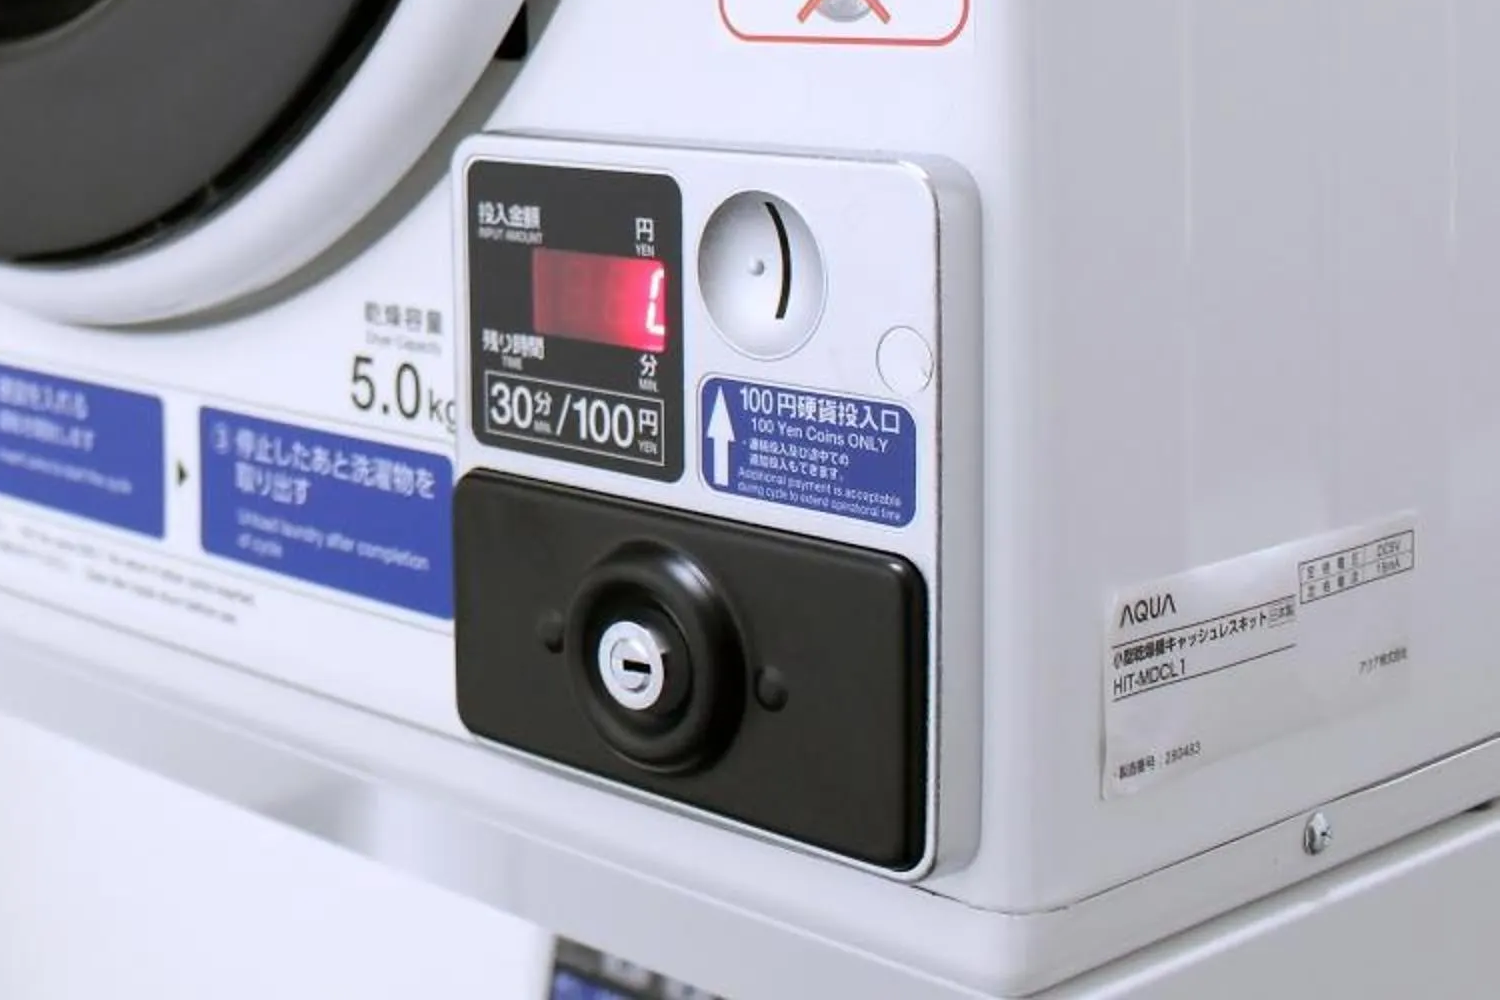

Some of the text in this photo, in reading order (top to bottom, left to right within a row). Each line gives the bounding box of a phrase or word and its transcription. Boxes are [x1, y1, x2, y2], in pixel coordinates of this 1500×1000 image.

[479, 201, 541, 229] 投入金額
[635, 217, 654, 242] 円
[636, 243, 654, 257] YEN
[483, 328, 544, 360] 残り時間
[640, 353, 657, 376] 分
[752, 418, 888, 453] 100 Yen Coins ONLY
[235, 428, 435, 499] 停止したあと洗濯物を
[235, 461, 311, 505] 取り出す
[737, 466, 786, 485] Additional
[788, 476, 831, 495] payment
[834, 486, 843, 496] is
[1119, 593, 1177, 628] AQUA
